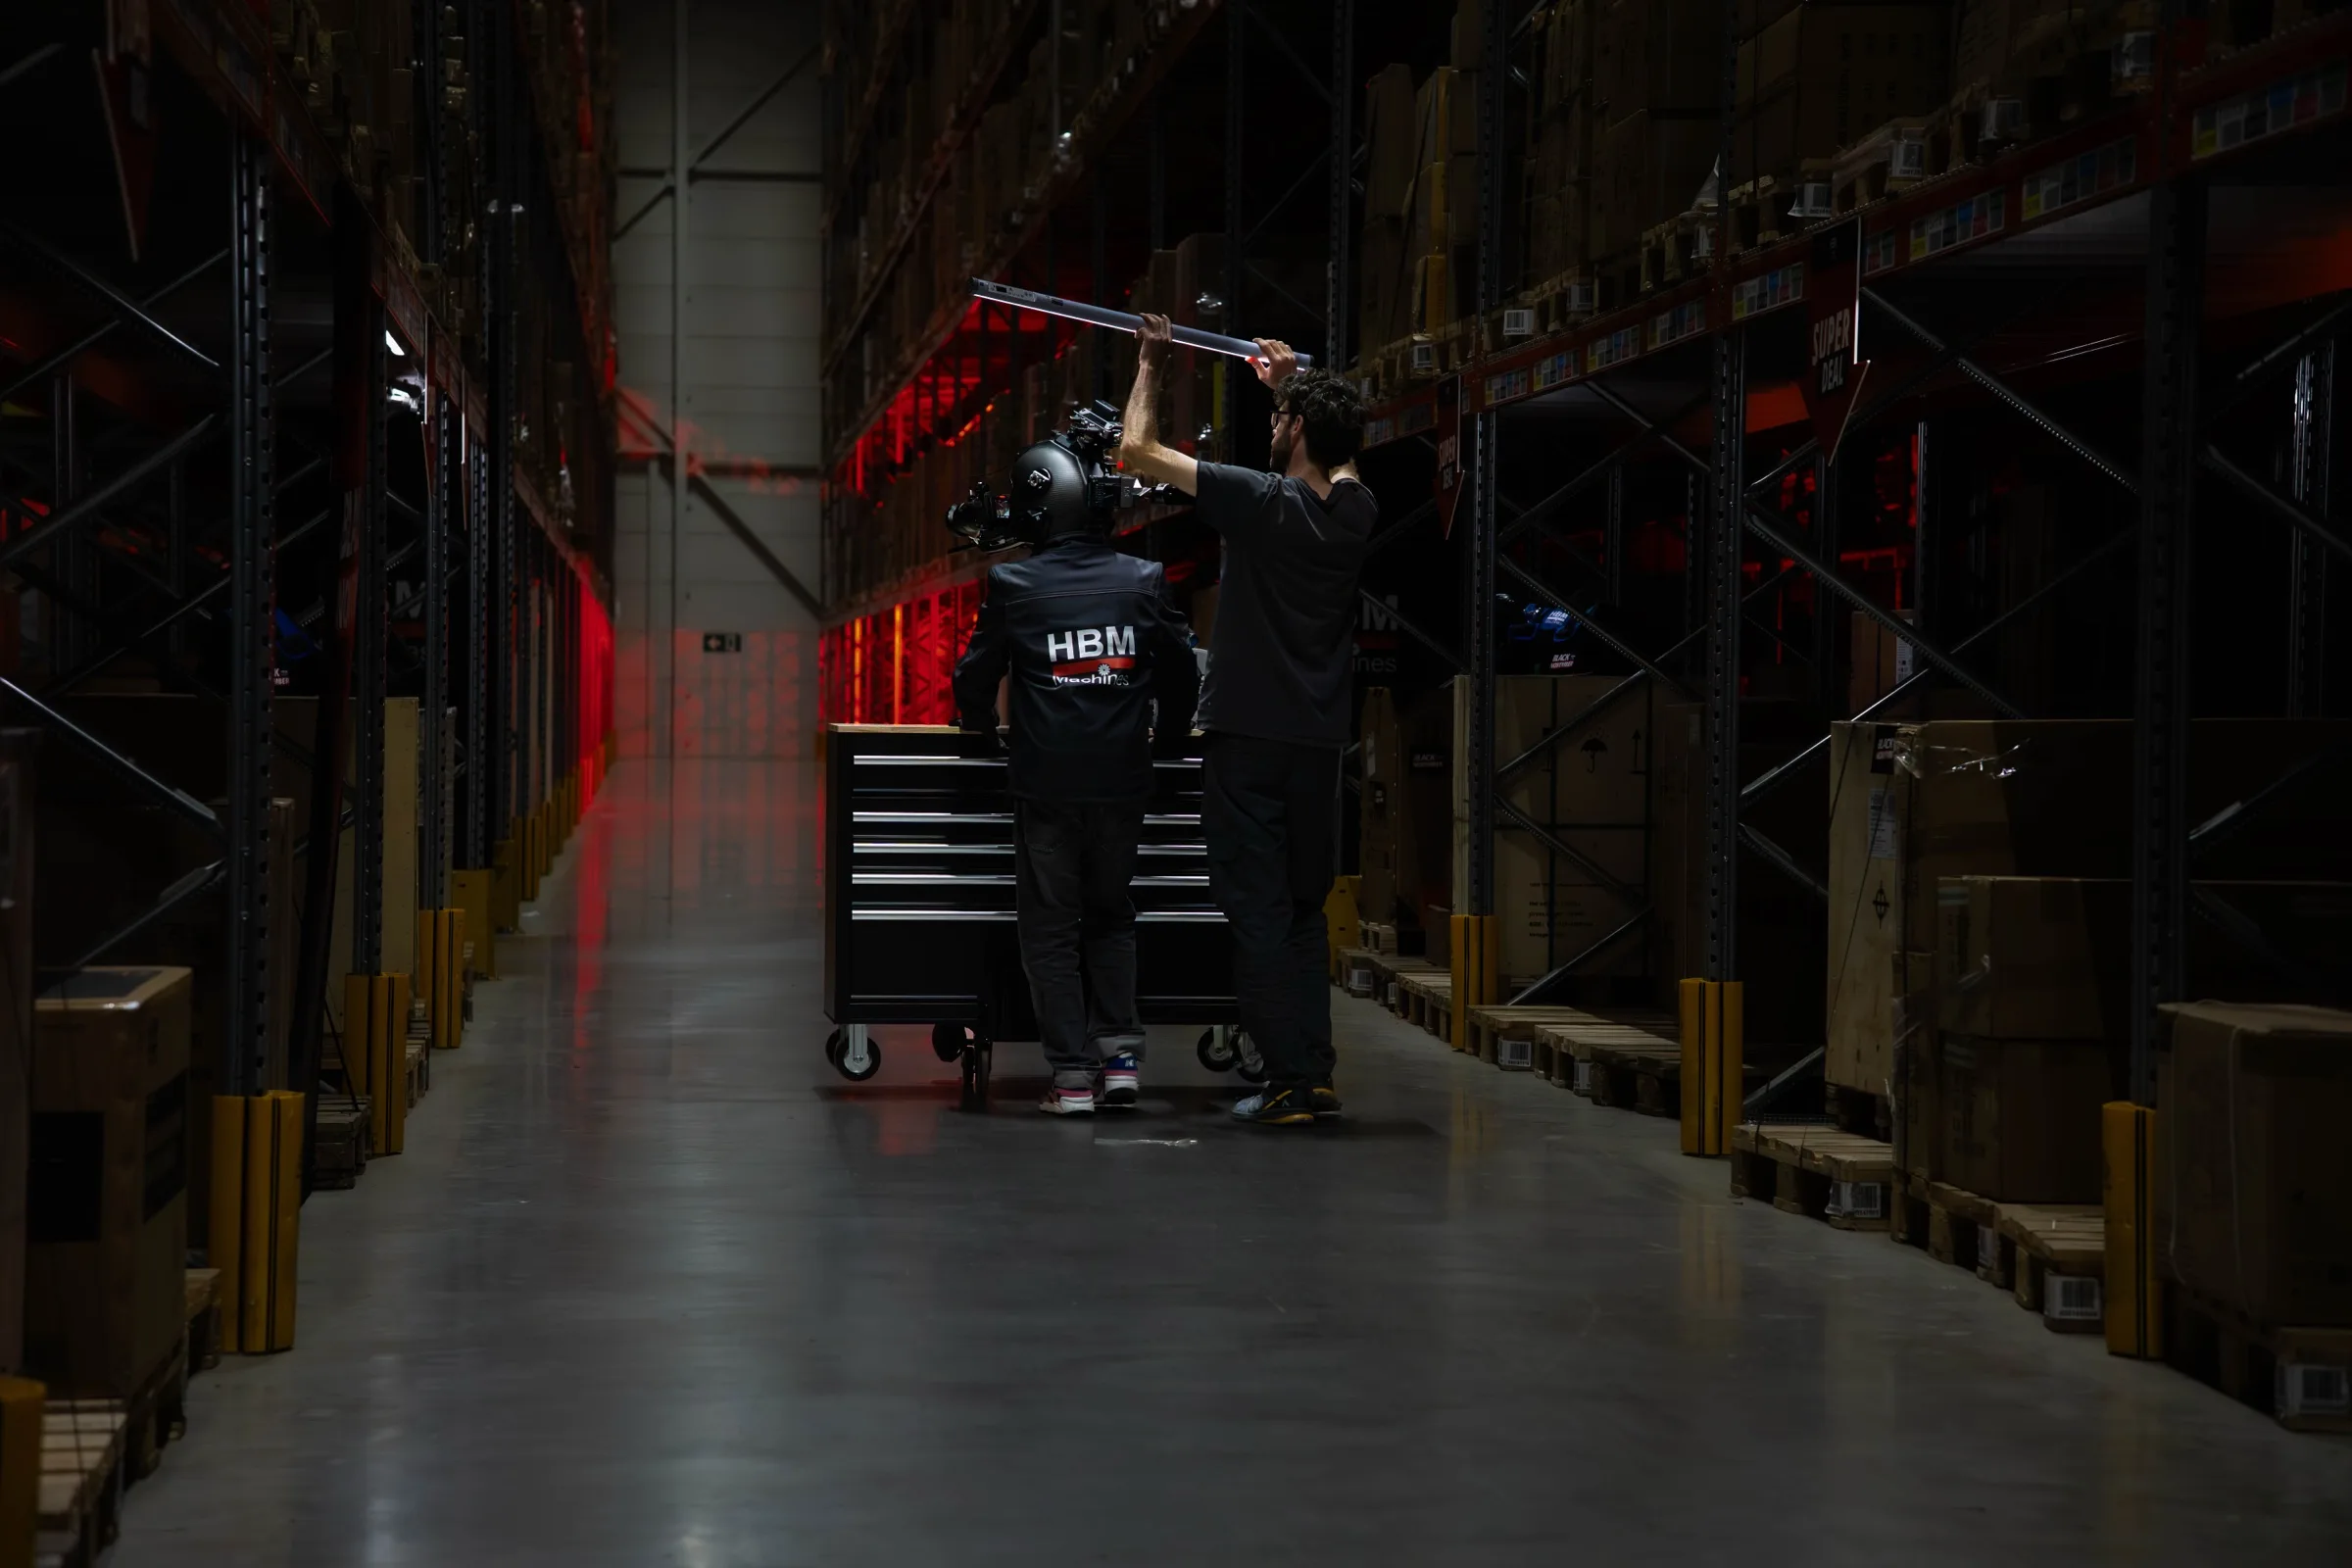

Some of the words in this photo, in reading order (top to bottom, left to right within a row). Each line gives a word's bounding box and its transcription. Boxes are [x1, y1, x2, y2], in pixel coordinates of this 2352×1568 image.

[1812, 307, 1850, 367] SUPER
[1822, 354, 1844, 394] DEAL
[1047, 625, 1137, 662] HBM
[1552, 654, 1571, 662] BLACK
[1352, 657, 1397, 673] ines
